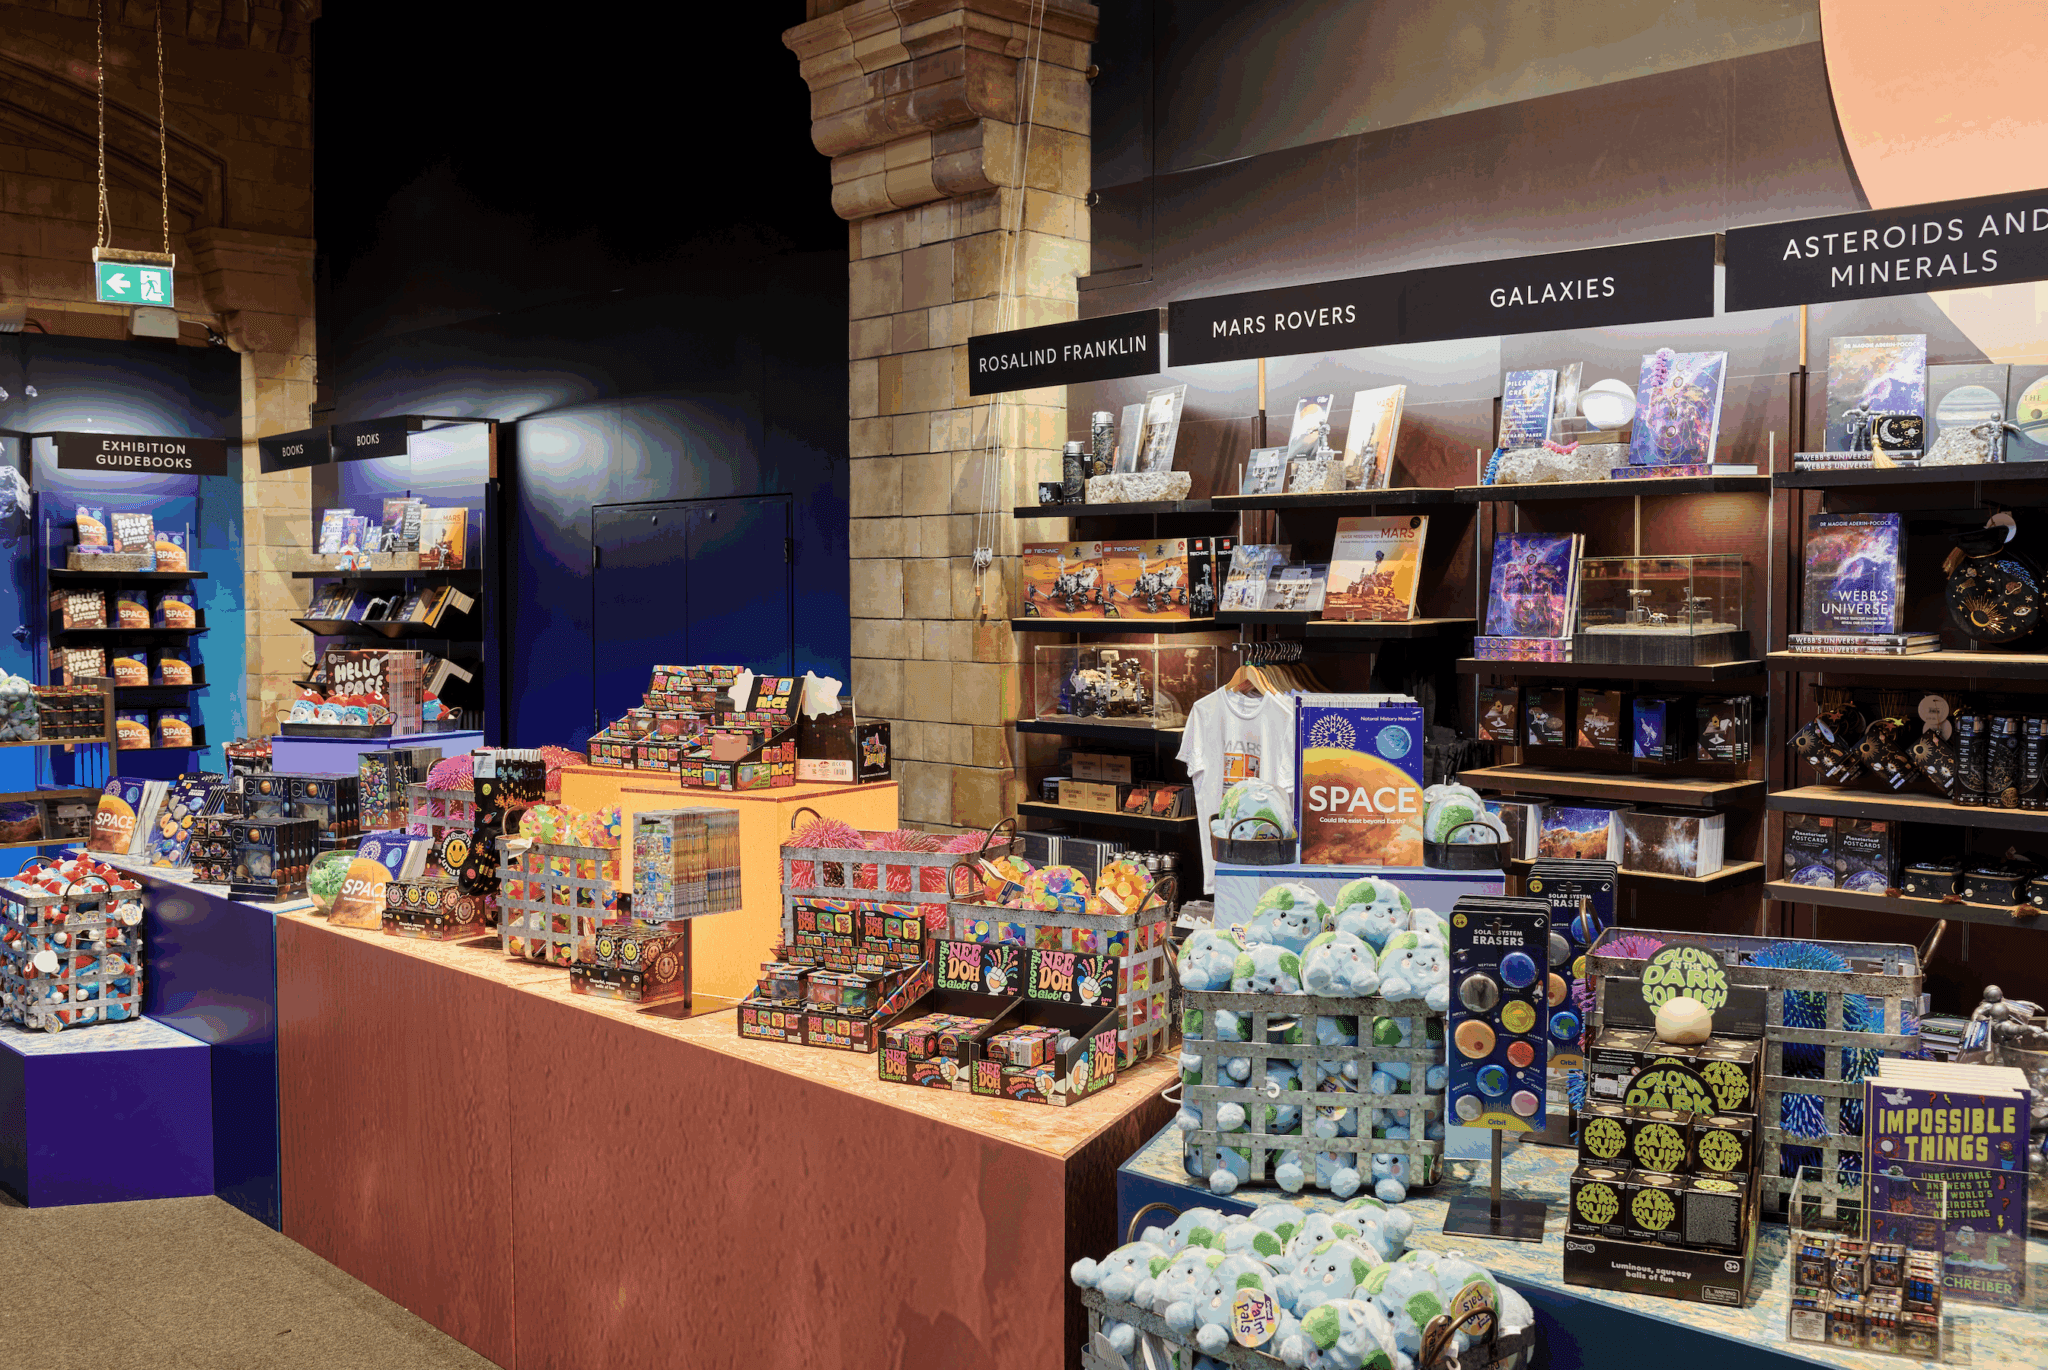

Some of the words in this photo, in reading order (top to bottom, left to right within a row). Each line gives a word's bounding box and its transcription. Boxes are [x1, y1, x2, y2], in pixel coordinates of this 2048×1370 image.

[1782, 217, 1965, 261] ASTEROIDS
[1978, 207, 2048, 239] AND
[1829, 248, 1999, 290] MINERALS
[1489, 276, 1617, 309] GALAXIES
[1212, 315, 1266, 339] MARS
[1274, 304, 1357, 332] ROVERS
[978, 348, 1057, 374] ROSALIND
[1063, 334, 1147, 361] FRANKLIN
[2024, 394, 2042, 402] THE
[356, 433, 380, 446] BOOKS
[102, 440, 186, 455] EXHIBITION
[282, 444, 304, 457] BOOKS
[95, 454, 193, 469] GUIDEBOOKS
[1833, 453, 1871, 461] UNIVERSE
[1803, 462, 1832, 470] WEBB'S
[79, 525, 105, 534] SPACE
[117, 517, 148, 530] HELLO
[118, 525, 150, 539] SPACE
[1380, 527, 1415, 539] MARS
[156, 550, 185, 559] SPACE
[68, 592, 99, 605] HELLO
[1838, 590, 1888, 601] WEBB'S
[69, 600, 101, 614] SPACE
[120, 609, 148, 619] SPACE
[166, 609, 194, 618] SPACE
[1821, 603, 1889, 615] UNIVERSE
[1796, 636, 1822, 645] WEBB'S
[1824, 636, 1860, 645] UNIVERSE
[68, 649, 99, 663] HELLO
[1795, 645, 1822, 654] WEBB'S
[1823, 645, 1859, 654] UNIVERSE
[69, 657, 101, 672] SPACE
[115, 667, 146, 676] SPACE
[163, 666, 190, 675] SPACE
[334, 657, 381, 683] HELLO
[756, 695, 789, 709] NICE
[118, 729, 148, 738] SPACE
[163, 727, 190, 736] SPACE
[1222, 739, 1262, 757] MARS
[1308, 786, 1417, 813] SPACE
[95, 811, 135, 830] SPACE
[1319, 816, 1337, 824] Could
[1338, 816, 1348, 824] life
[1348, 816, 1362, 824] exist
[1363, 816, 1385, 826] beyond
[1386, 816, 1406, 824] Earth?
[1791, 835, 1829, 844] POSTCARDS
[1843, 840, 1881, 849] POSTCARDS
[797, 910, 816, 926] NEE
[798, 918, 816, 932] DOH
[864, 916, 884, 931] NEE
[865, 924, 883, 938] DOH
[1472, 935, 1525, 947] ERASERS
[948, 941, 982, 967] NEE
[1654, 947, 1719, 970] GLOW
[947, 957, 981, 982] DOH
[1039, 950, 1075, 977] NEE
[1670, 962, 1681, 970] IN
[1683, 962, 1703, 971] THE
[1038, 966, 1074, 992] DOH
[1642, 964, 1728, 990] DARK
[946, 979, 971, 991] Glob!
[1037, 989, 1063, 1001] Glob!
[1095, 1028, 1118, 1056] NEE
[1527, 1033, 1544, 1042] SATURN
[885, 1048, 907, 1066] NEE
[1560, 1058, 1577, 1067] Orbit
[886, 1059, 907, 1076] DOH
[978, 1060, 1001, 1079] NEE
[1094, 1051, 1117, 1079] DOH
[978, 1071, 1001, 1090] DOH
[1636, 1070, 1705, 1096] GLOW
[1700, 1071, 1750, 1087] DARK
[1452, 1081, 1469, 1092] MERCURY
[1654, 1086, 1666, 1094] IN
[1668, 1087, 1688, 1096] THE
[1625, 1088, 1716, 1116] DARK
[1487, 1118, 1507, 1126] Orbit
[1878, 1106, 2017, 1135] IMPOSSIBLE
[1584, 1126, 1627, 1140] DARK
[1634, 1133, 1686, 1150] DARK
[1699, 1138, 1743, 1154] DARK
[1904, 1135, 1989, 1162] THINGS
[1921, 1170, 1993, 1181] UNBELIEVABLE
[1926, 1182, 1972, 1191] ANSWERS
[1976, 1180, 1991, 1189] TO
[1576, 1190, 1619, 1205] DARK
[1950, 1189, 1994, 1200] WORLD'S
[1632, 1197, 1676, 1212] DARK
[1611, 1261, 1655, 1275] Luminous,
[1655, 1267, 1692, 1279] squeezy
[1726, 1262, 1738, 1270] 3+
[1625, 1270, 1648, 1280] balls
[1649, 1272, 1658, 1281] of
[1659, 1273, 1675, 1283] fun
[1462, 1289, 1484, 1312] Pals
[1236, 1302, 1251, 1333] Pals
[1251, 1299, 1266, 1335] Palm
